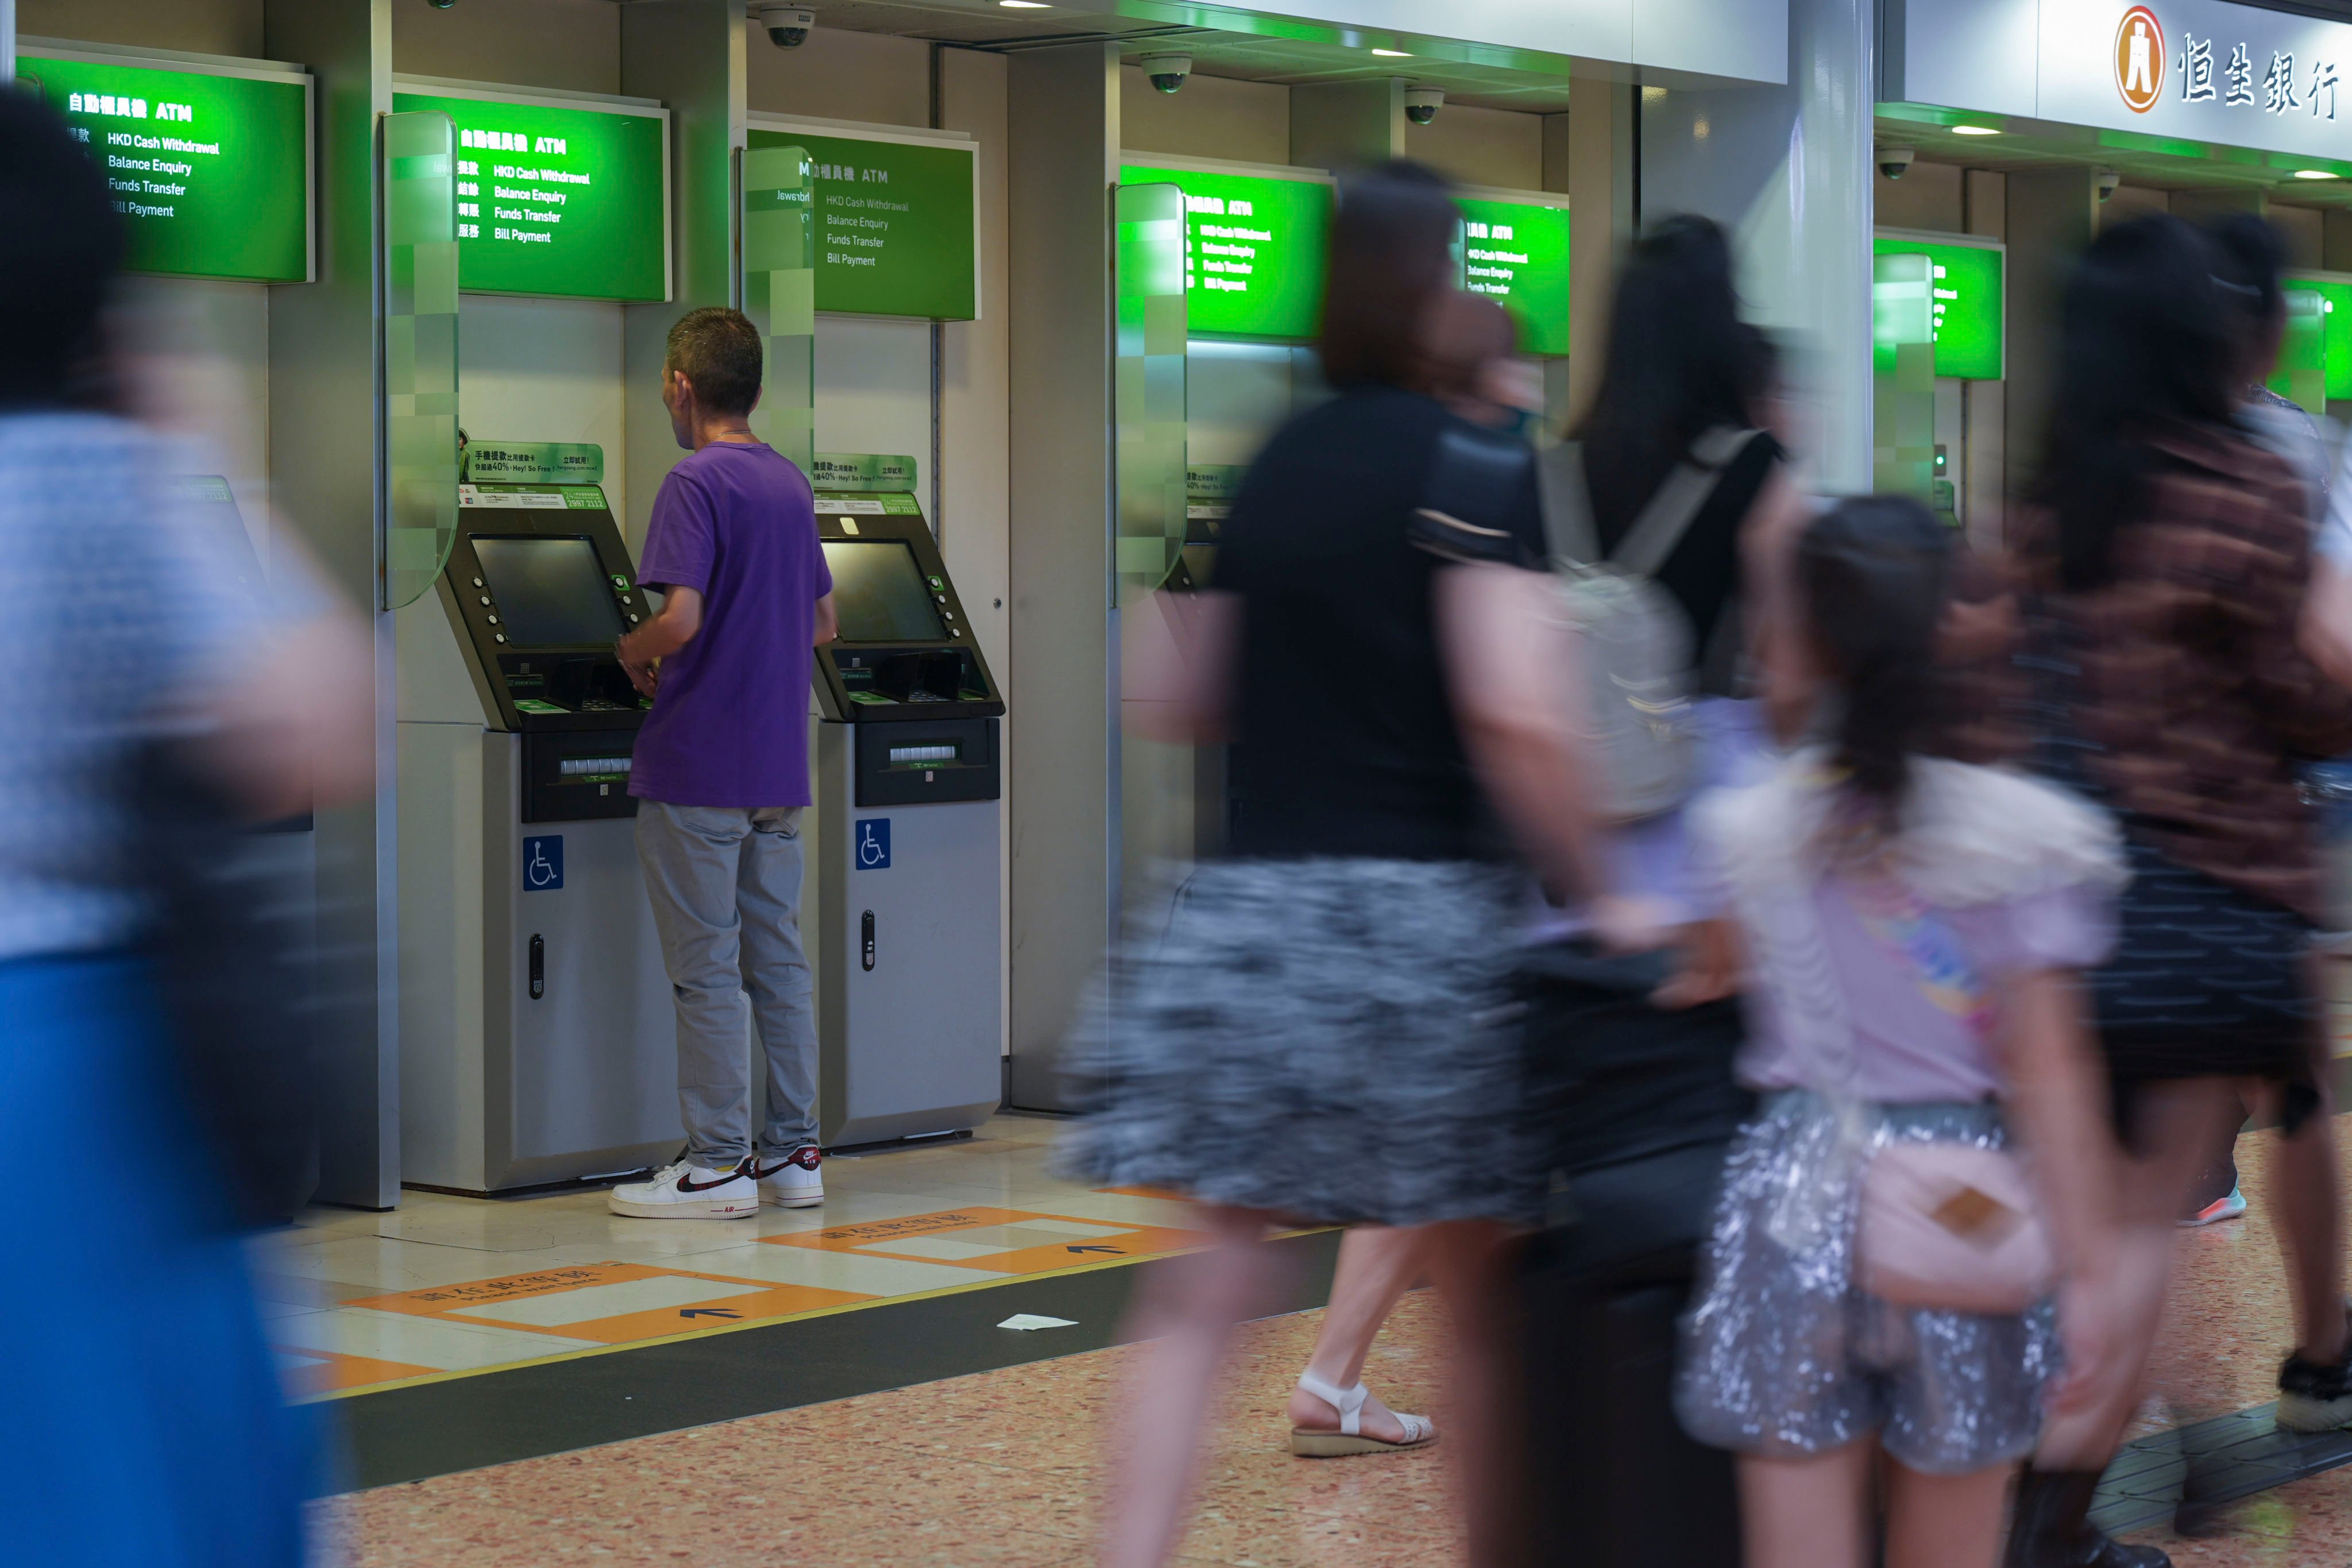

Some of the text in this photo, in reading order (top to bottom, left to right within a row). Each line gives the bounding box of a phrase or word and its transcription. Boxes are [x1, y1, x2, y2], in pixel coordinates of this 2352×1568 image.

[2177, 32, 2339, 122] 恒生銀行
[156, 102, 192, 122] ATM
[108, 133, 132, 146] HKD
[134, 135, 160, 149] Cash
[162, 137, 219, 155] Withdrawal
[535, 137, 566, 155] ATM
[109, 155, 192, 176] Balance Enquiry
[493, 165, 515, 178] HKD
[516, 167, 539, 180] Cash
[540, 168, 590, 184] Withdrawal
[862, 169, 888, 184] ATM
[109, 178, 186, 195] Funds Transfer
[495, 186, 531, 200] Balance
[532, 189, 566, 205] Enquiry
[827, 195, 909, 212] HKD Cash Withdrawal
[129, 202, 173, 217] Payment
[495, 207, 522, 220] Funds
[523, 209, 561, 222] Transfer
[827, 214, 888, 231] Balance Enquiry
[459, 224, 551, 243] 服務 Bill Payment
[827, 233, 884, 248] Funds Transfer
[1492, 225, 1513, 240] ATM
[827, 253, 875, 267] Bill Payment
[1480, 250, 1495, 261] Cash
[1467, 265, 1513, 280] Balance Enquiry
[1485, 283, 1510, 294] Transfer
[409, 1270, 602, 1301] 請在此等候
[460, 1291, 521, 1301] Please
[557, 1278, 602, 1286] here
